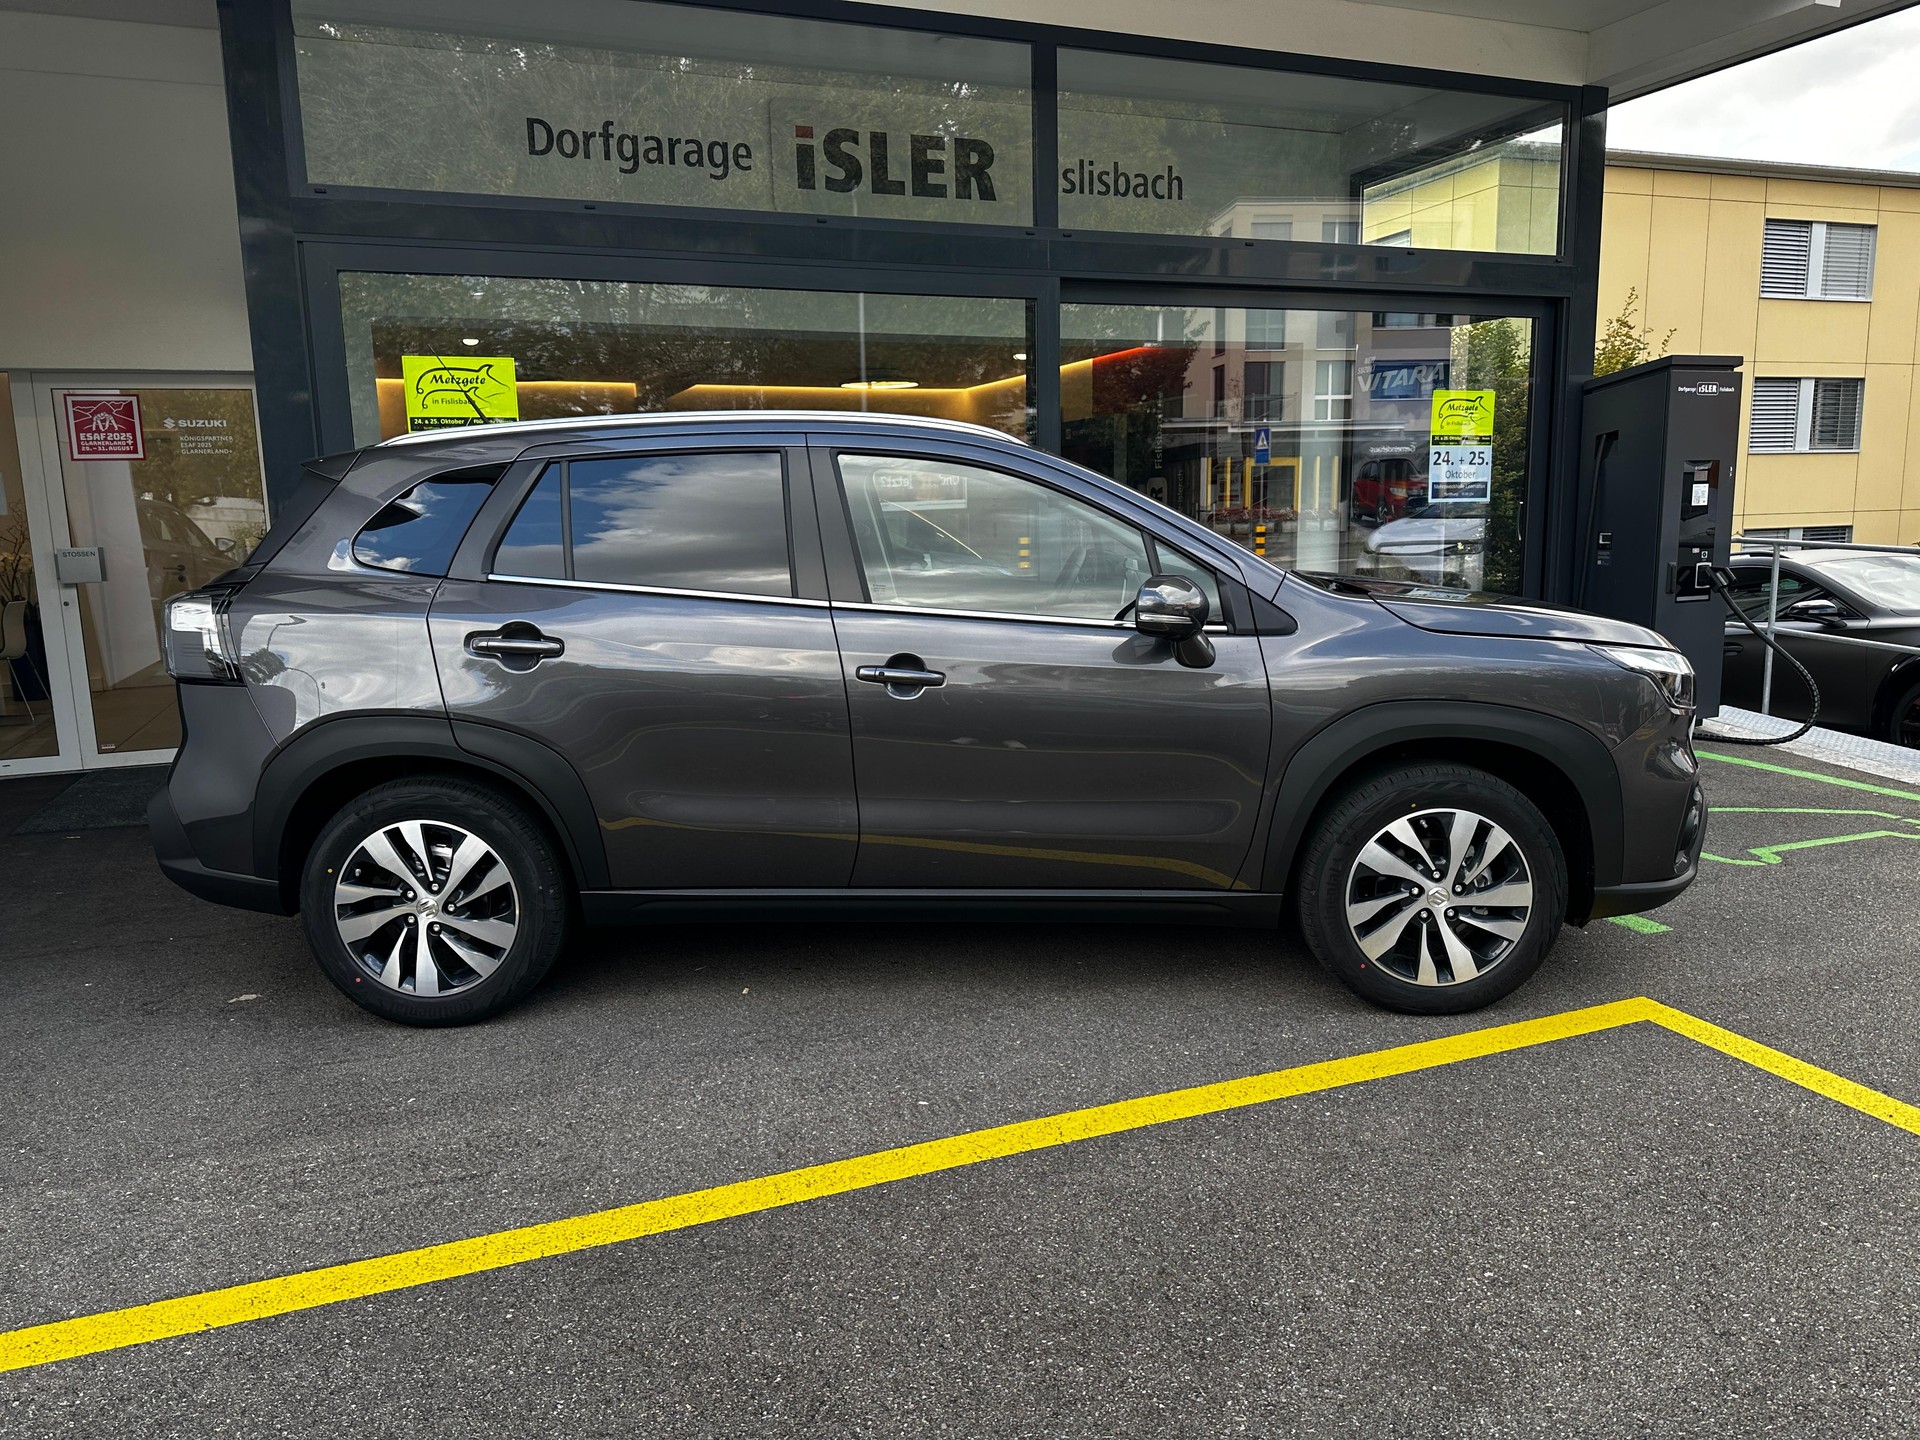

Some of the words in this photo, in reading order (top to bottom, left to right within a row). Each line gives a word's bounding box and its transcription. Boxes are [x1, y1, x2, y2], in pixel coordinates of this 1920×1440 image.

[526, 117, 753, 180] Dorfgarage
[1062, 159, 1183, 201] slisbach
[430, 374, 486, 387] Metzgete
[1357, 362, 1445, 393] VITARA
[178, 419, 227, 428] SUZUKI
[80, 433, 106, 441] ESAF
[107, 433, 132, 441] 2025
[1433, 450, 1454, 466] 24.
[1459, 456, 1465, 464] +
[1469, 450, 1489, 466] 25.
[1445, 470, 1476, 479] Oktober
